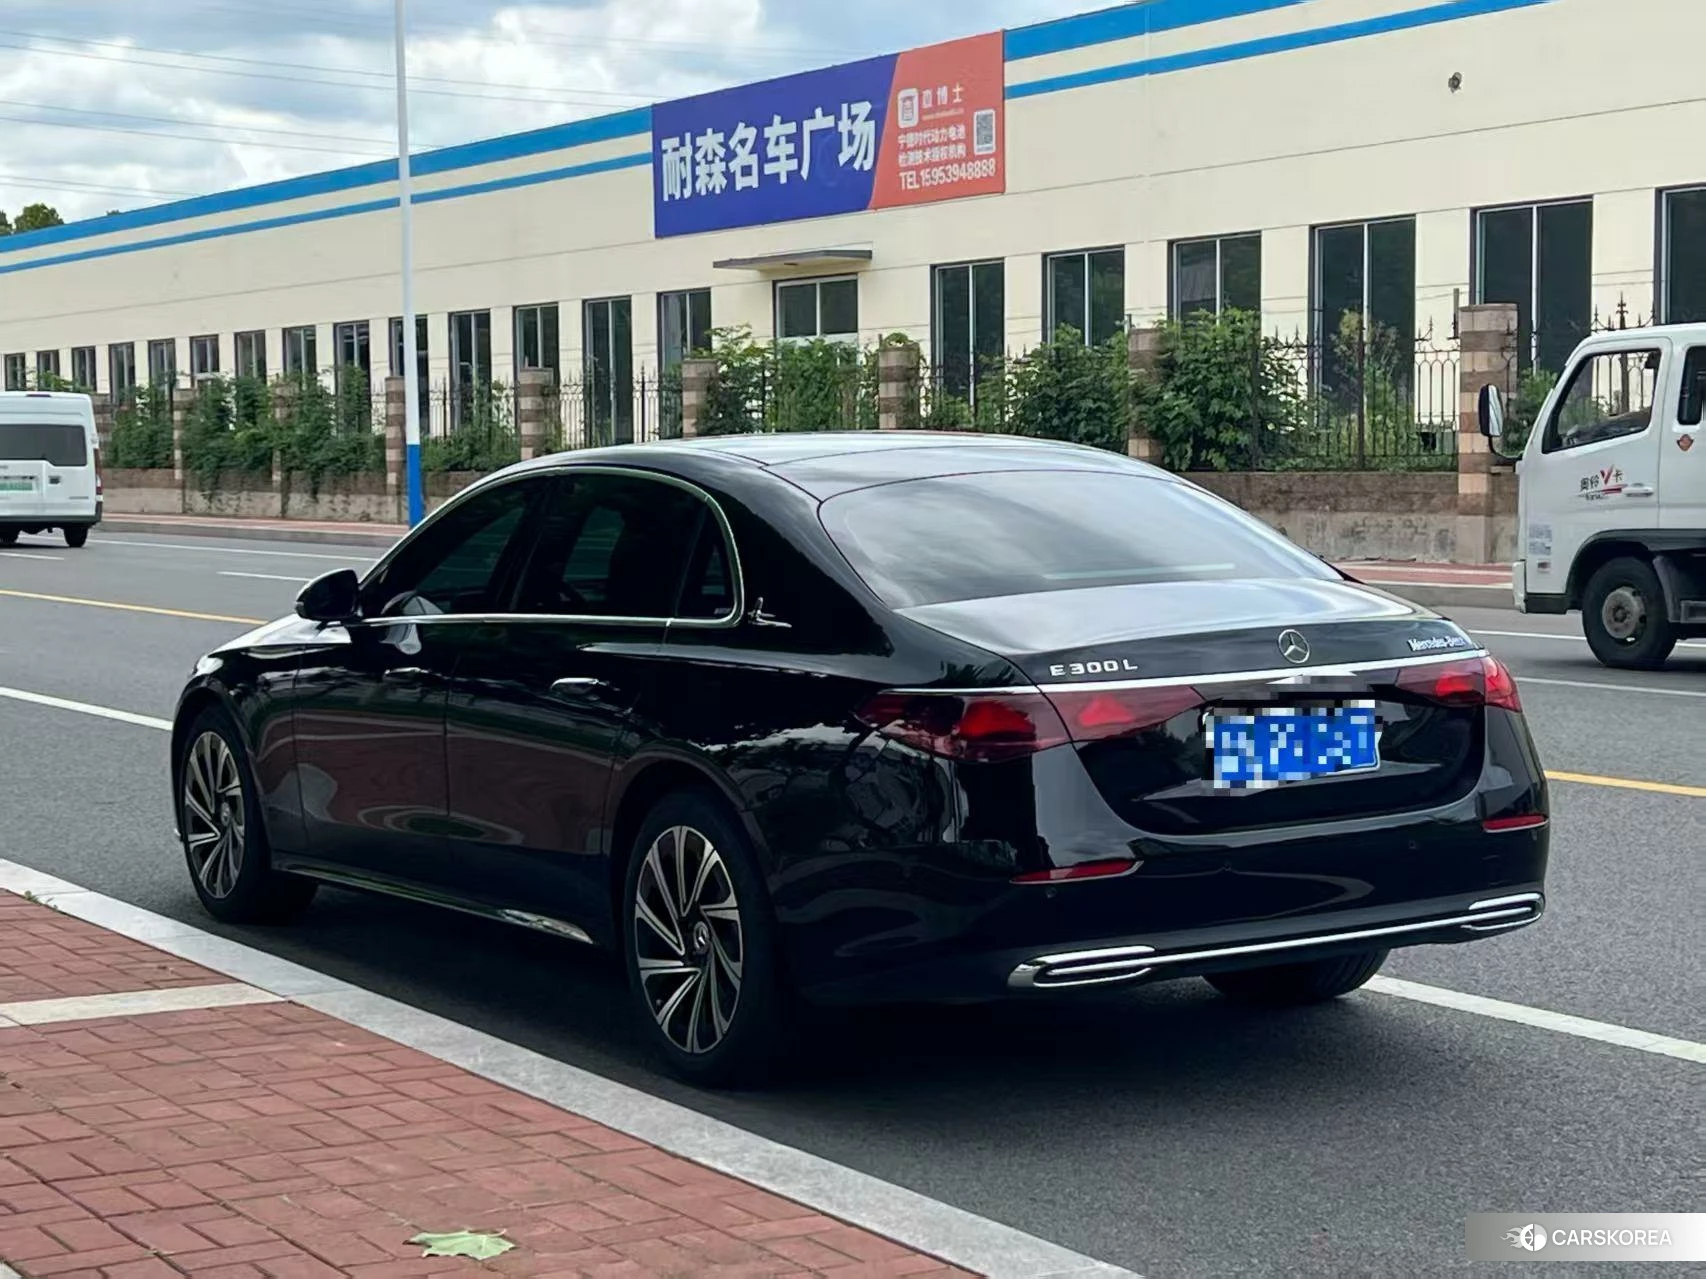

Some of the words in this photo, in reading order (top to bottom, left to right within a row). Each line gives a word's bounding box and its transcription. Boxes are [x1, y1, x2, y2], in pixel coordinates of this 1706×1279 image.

[661, 101, 876, 201] 耐森名车广场
